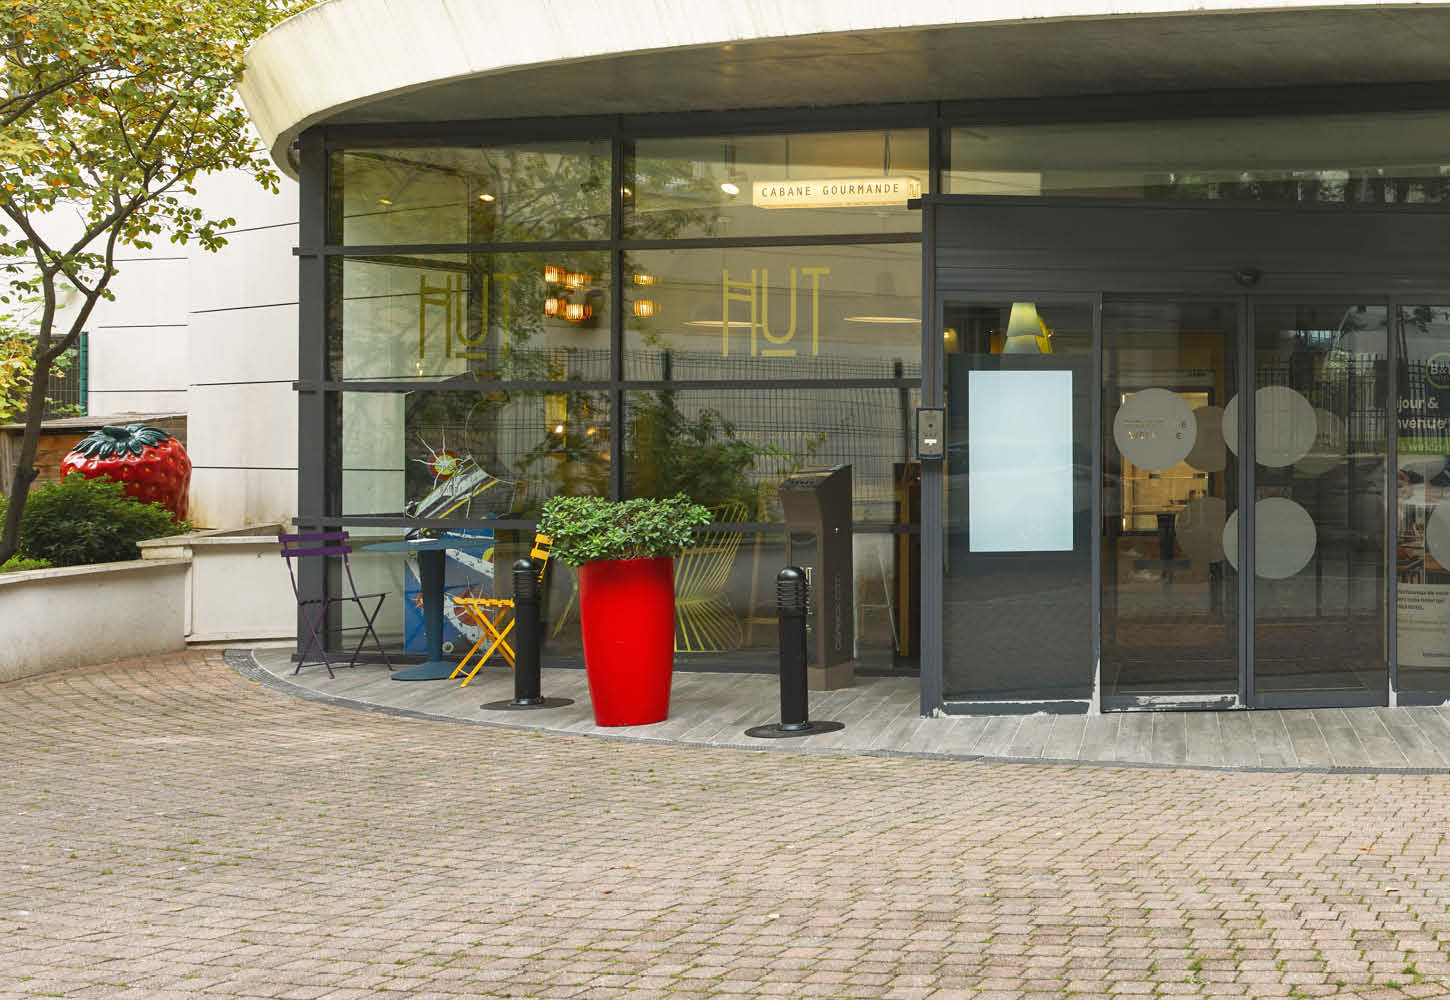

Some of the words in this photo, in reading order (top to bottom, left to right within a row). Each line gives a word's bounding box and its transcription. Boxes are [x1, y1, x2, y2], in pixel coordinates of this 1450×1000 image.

[761, 186, 812, 197] CABANE
[822, 183, 900, 195] GOURMANDE
[420, 273, 520, 359] HUT
[722, 267, 831, 357] HUT
